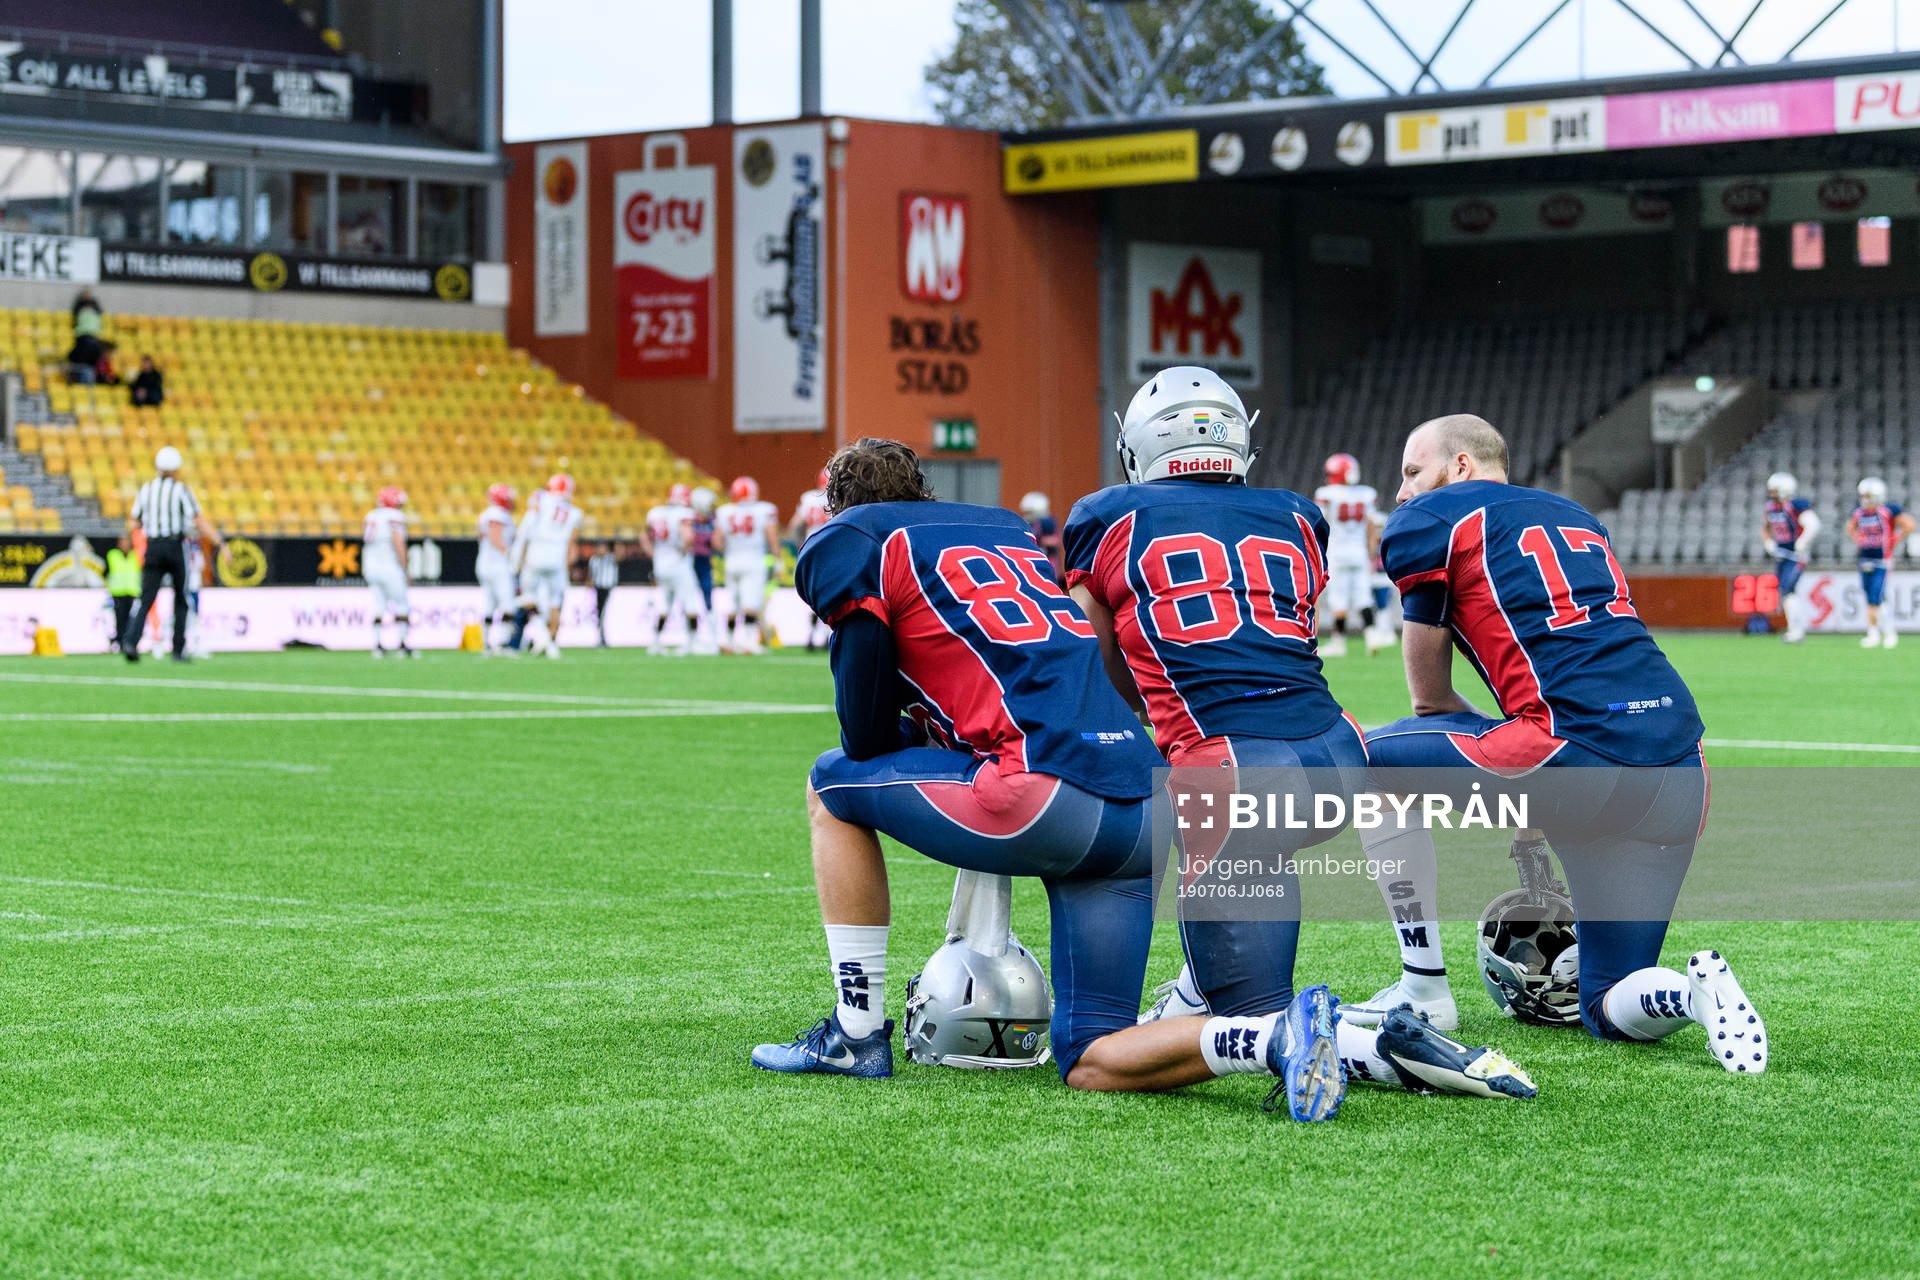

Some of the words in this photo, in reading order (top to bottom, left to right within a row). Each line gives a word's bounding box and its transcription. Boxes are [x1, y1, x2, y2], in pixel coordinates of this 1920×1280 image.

[65, 64, 113, 91] ALL
[1659, 98, 1780, 137] Folksam
[623, 189, 705, 246] City
[1149, 255, 1243, 359] MAX
[888, 313, 981, 355] BORÅS
[896, 357, 970, 396] STAD
[1168, 457, 1232, 475] Riddell
[935, 545, 1098, 646] 85
[1137, 532, 1316, 647] 80
[1517, 525, 1638, 632] 17
